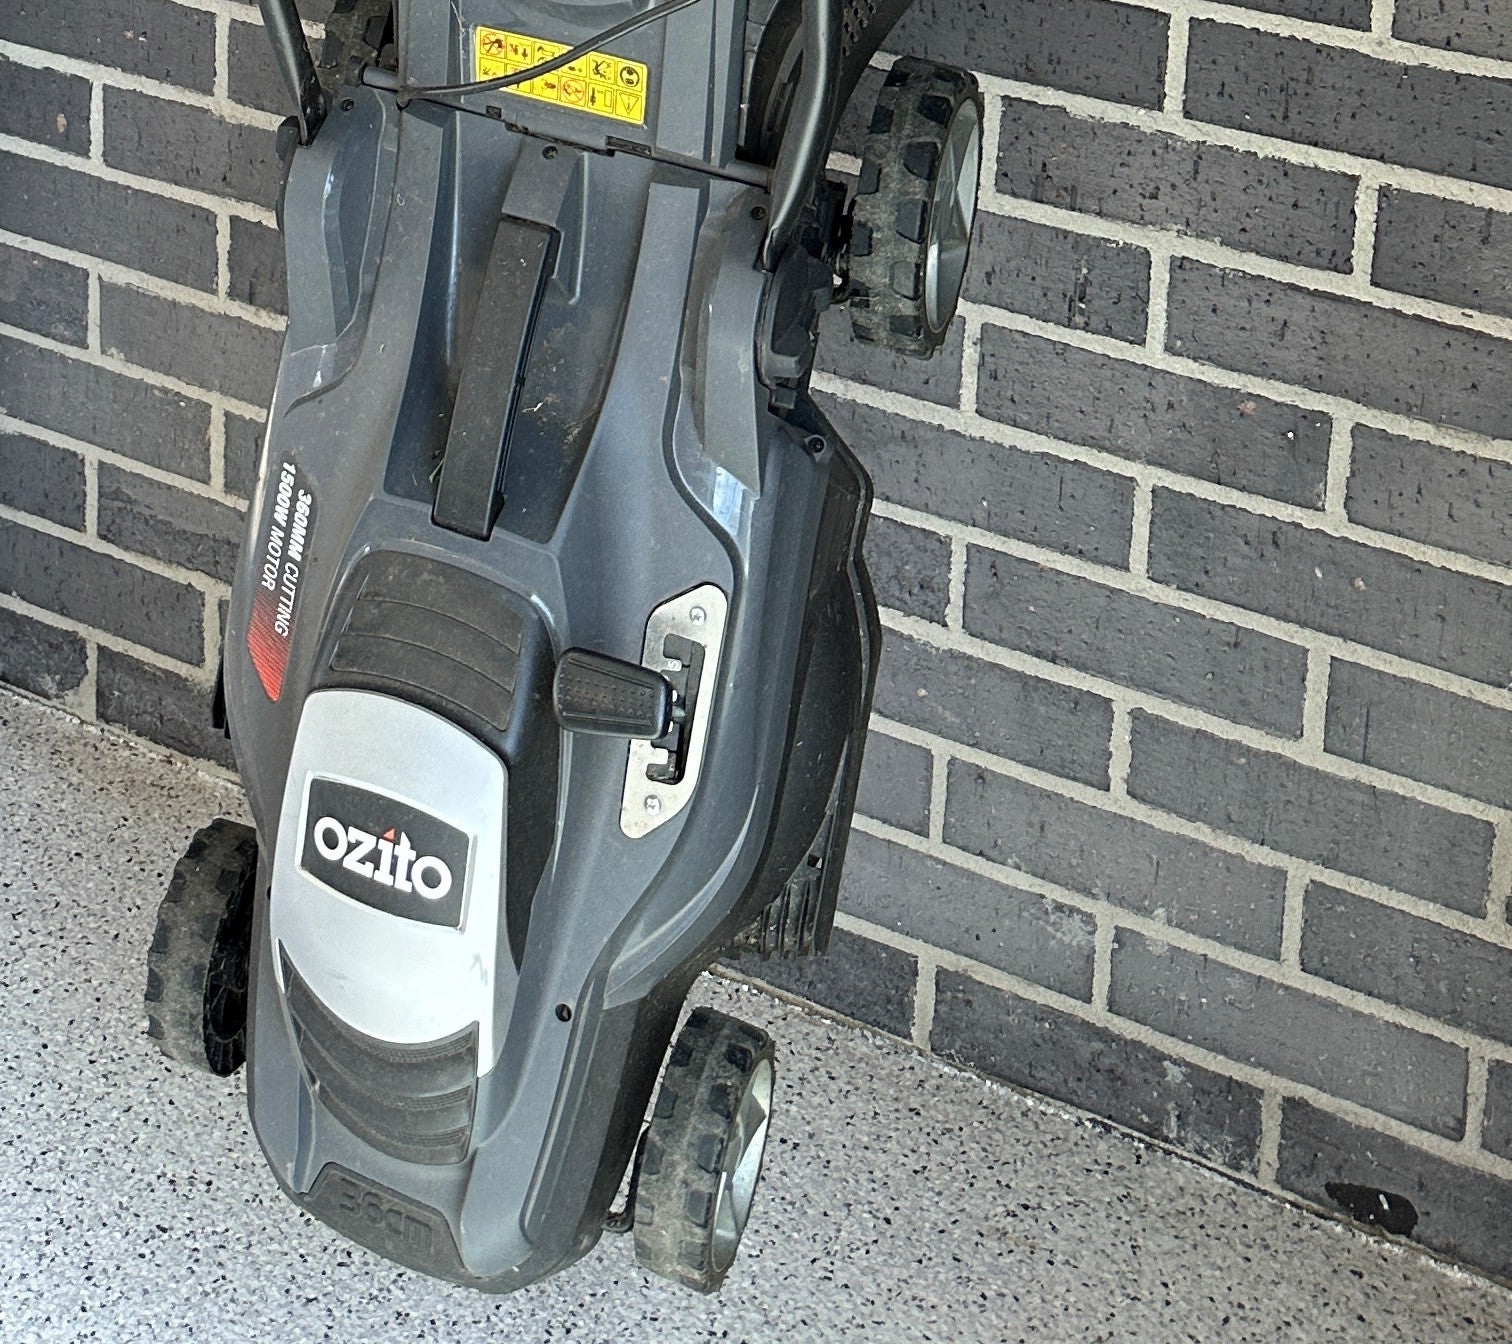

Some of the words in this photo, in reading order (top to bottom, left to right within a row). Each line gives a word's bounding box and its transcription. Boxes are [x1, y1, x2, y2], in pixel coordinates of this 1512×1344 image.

[273, 462, 297, 528] 1500W
[287, 489, 313, 562] 360MM
[261, 525, 285, 591] MOTOR
[274, 561, 300, 639] CUTTING
[313, 816, 453, 900] ozito
